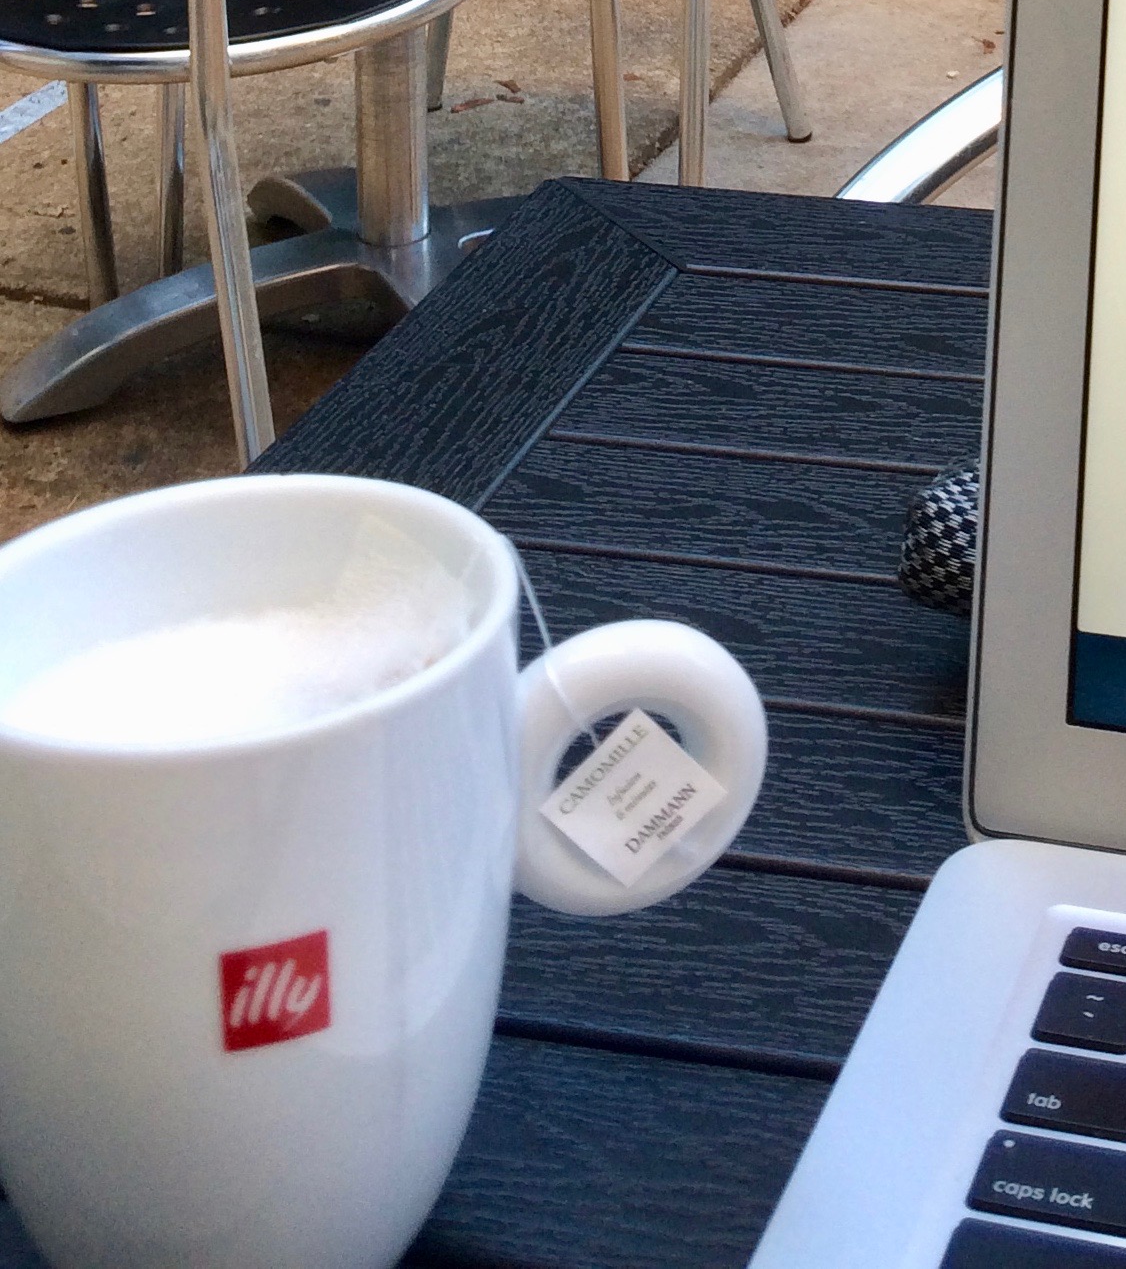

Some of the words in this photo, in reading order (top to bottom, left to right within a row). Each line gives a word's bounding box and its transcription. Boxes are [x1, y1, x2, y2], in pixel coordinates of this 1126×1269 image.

[625, 783, 697, 853] DAMMANN
[229, 958, 321, 1031] illy
[1026, 1092, 1062, 1110] tab
[992, 1180, 1045, 1201] caps
[1049, 1187, 1094, 1210] lock
